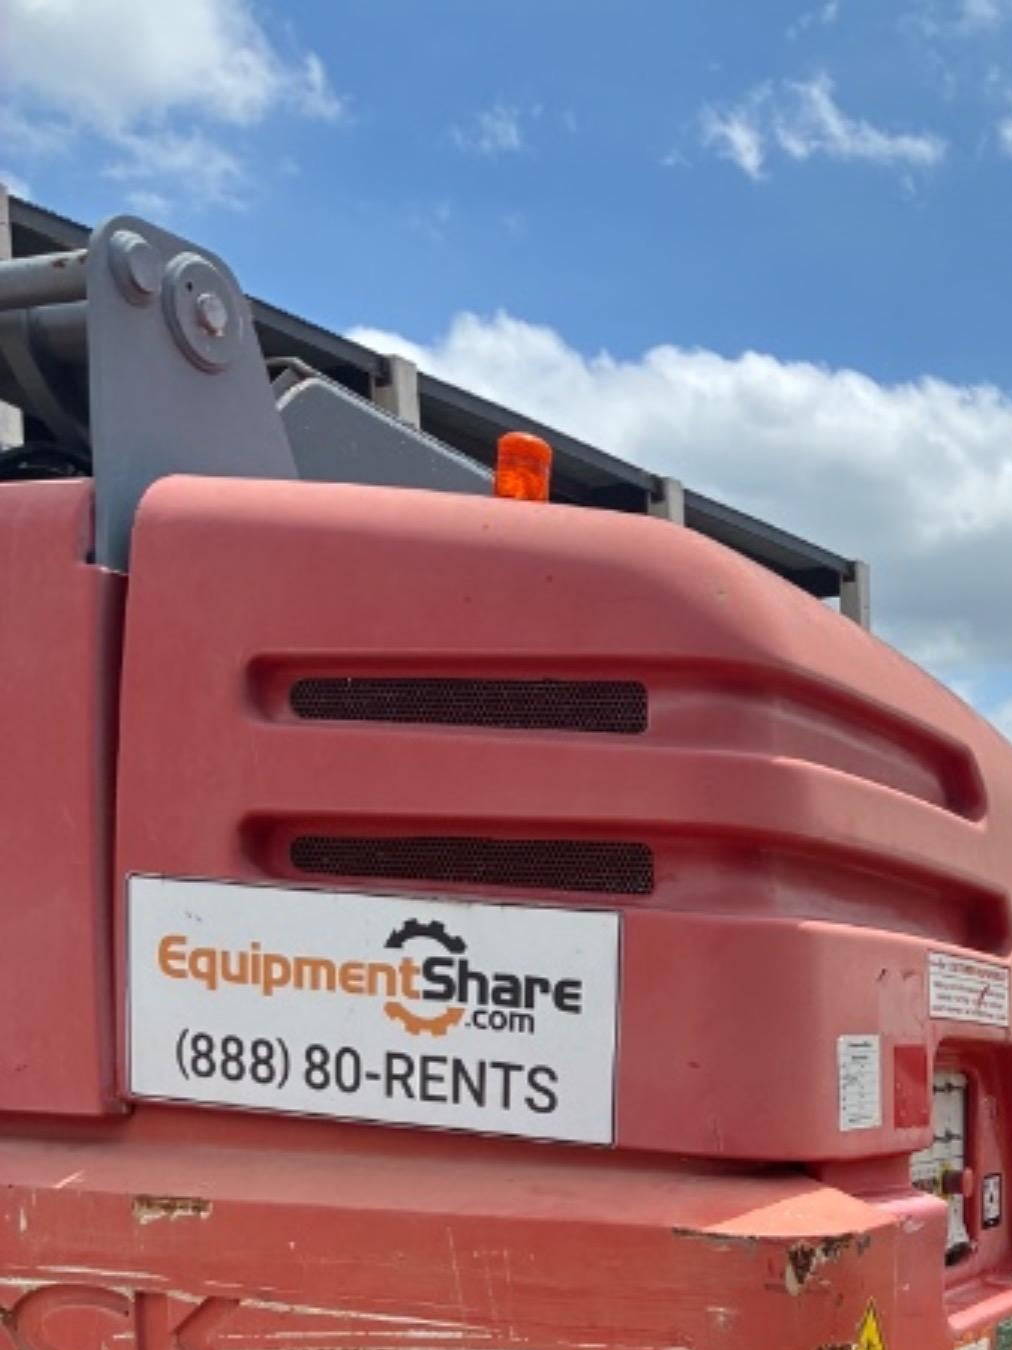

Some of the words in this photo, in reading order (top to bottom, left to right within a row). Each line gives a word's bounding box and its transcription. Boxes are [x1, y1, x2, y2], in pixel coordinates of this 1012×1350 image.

[157, 934, 582, 1014] EquipmentShare
[465, 1004, 535, 1034] .com
[176, 1028, 290, 1088] (888)
[305, 1044, 558, 1114] 80-RENTS
